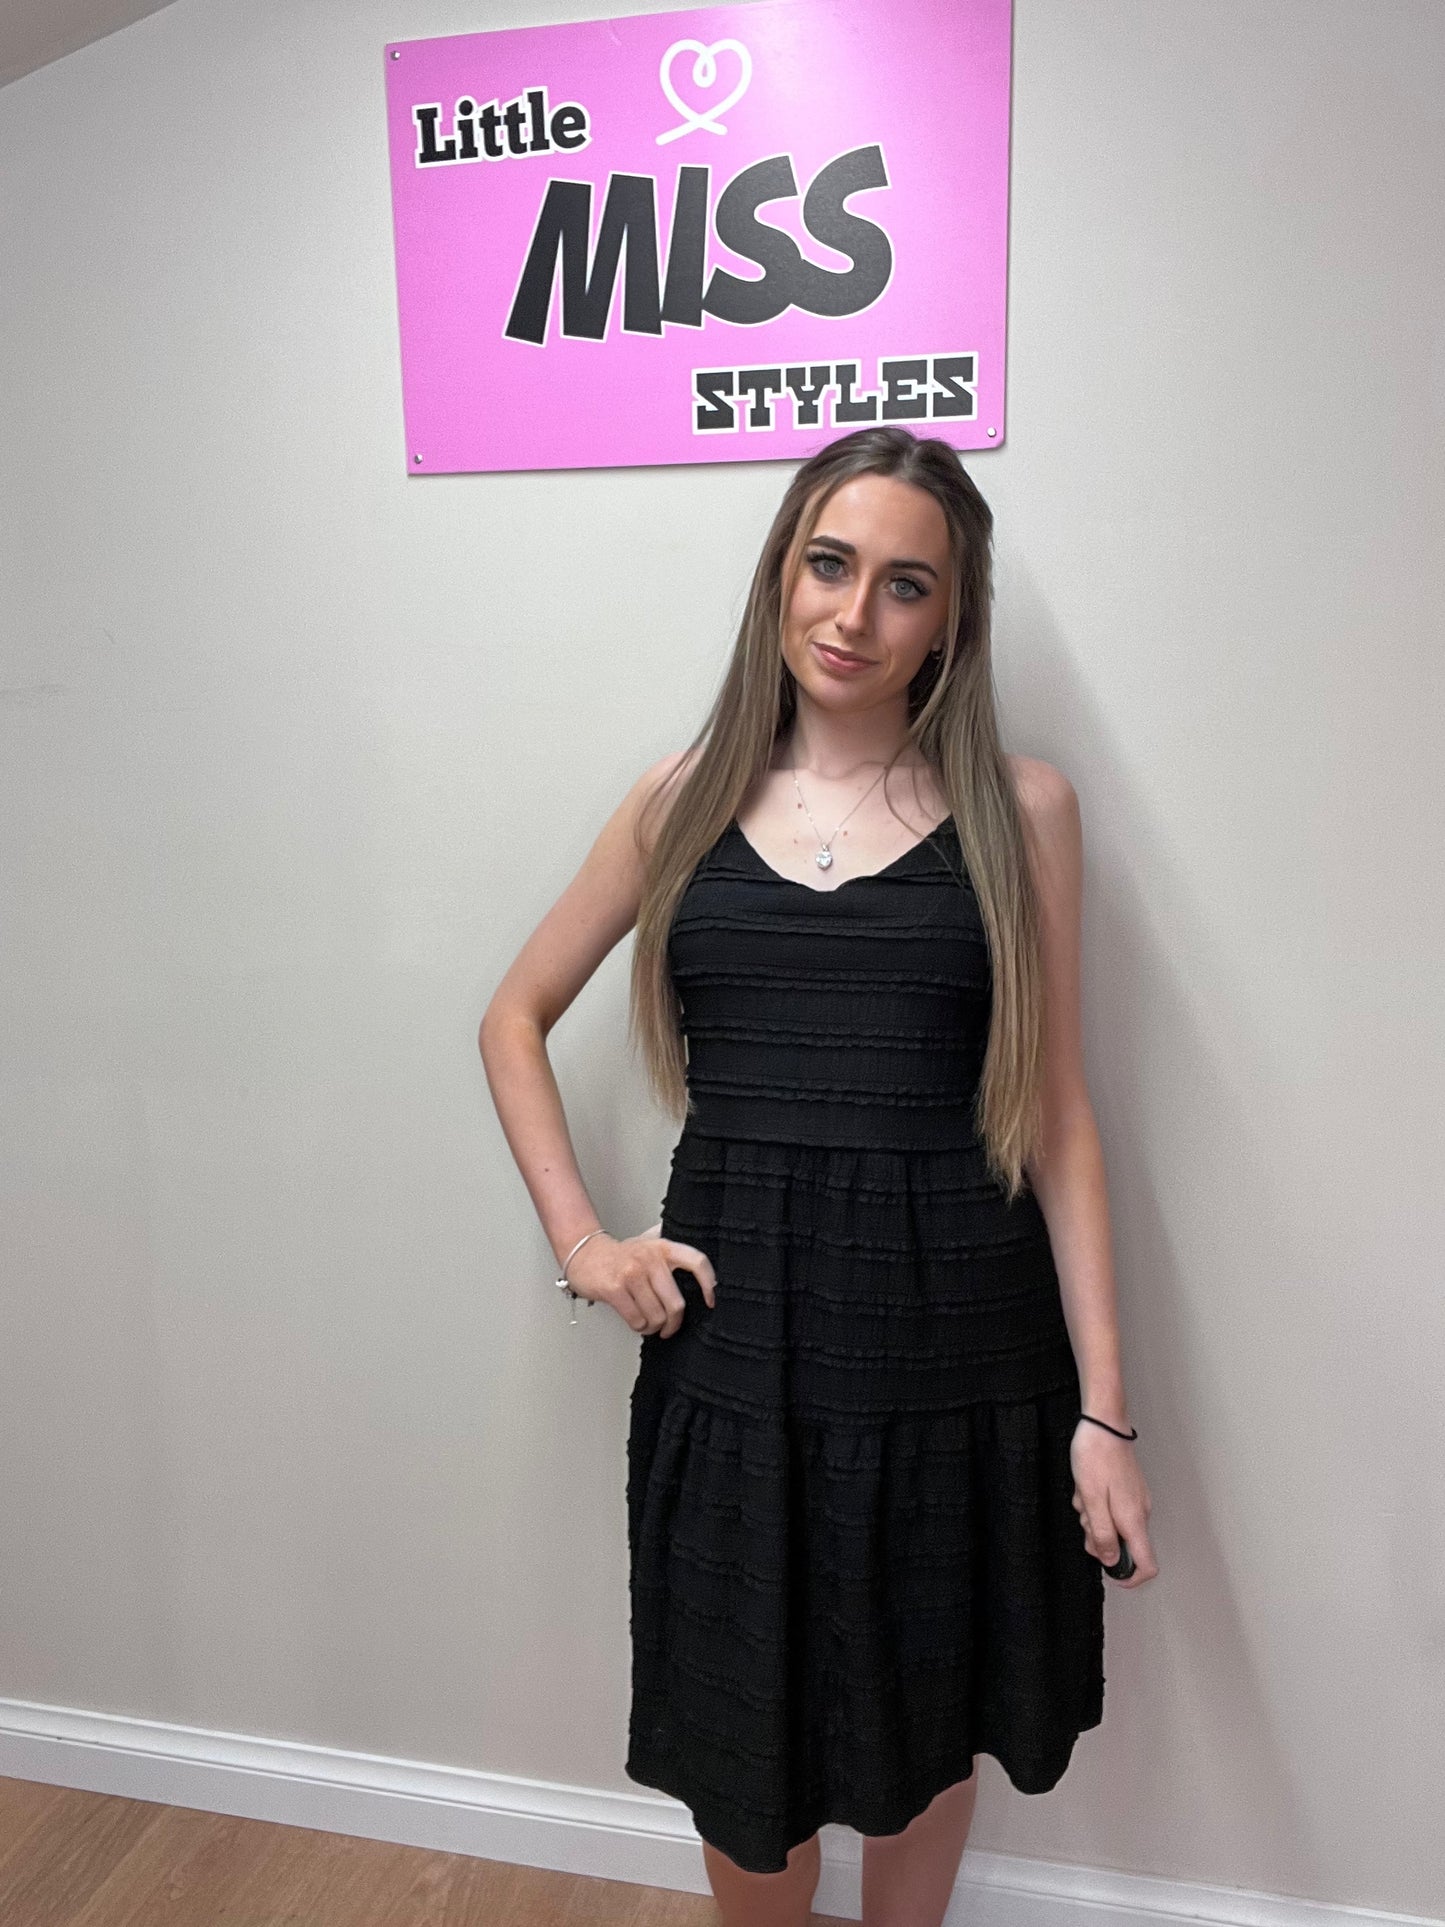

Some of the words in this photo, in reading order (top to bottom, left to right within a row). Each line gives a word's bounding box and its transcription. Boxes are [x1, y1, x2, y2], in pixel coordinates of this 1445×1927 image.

[415, 90, 587, 164] Little
[504, 144, 893, 346] MISS
[696, 356, 975, 430] STYLES
